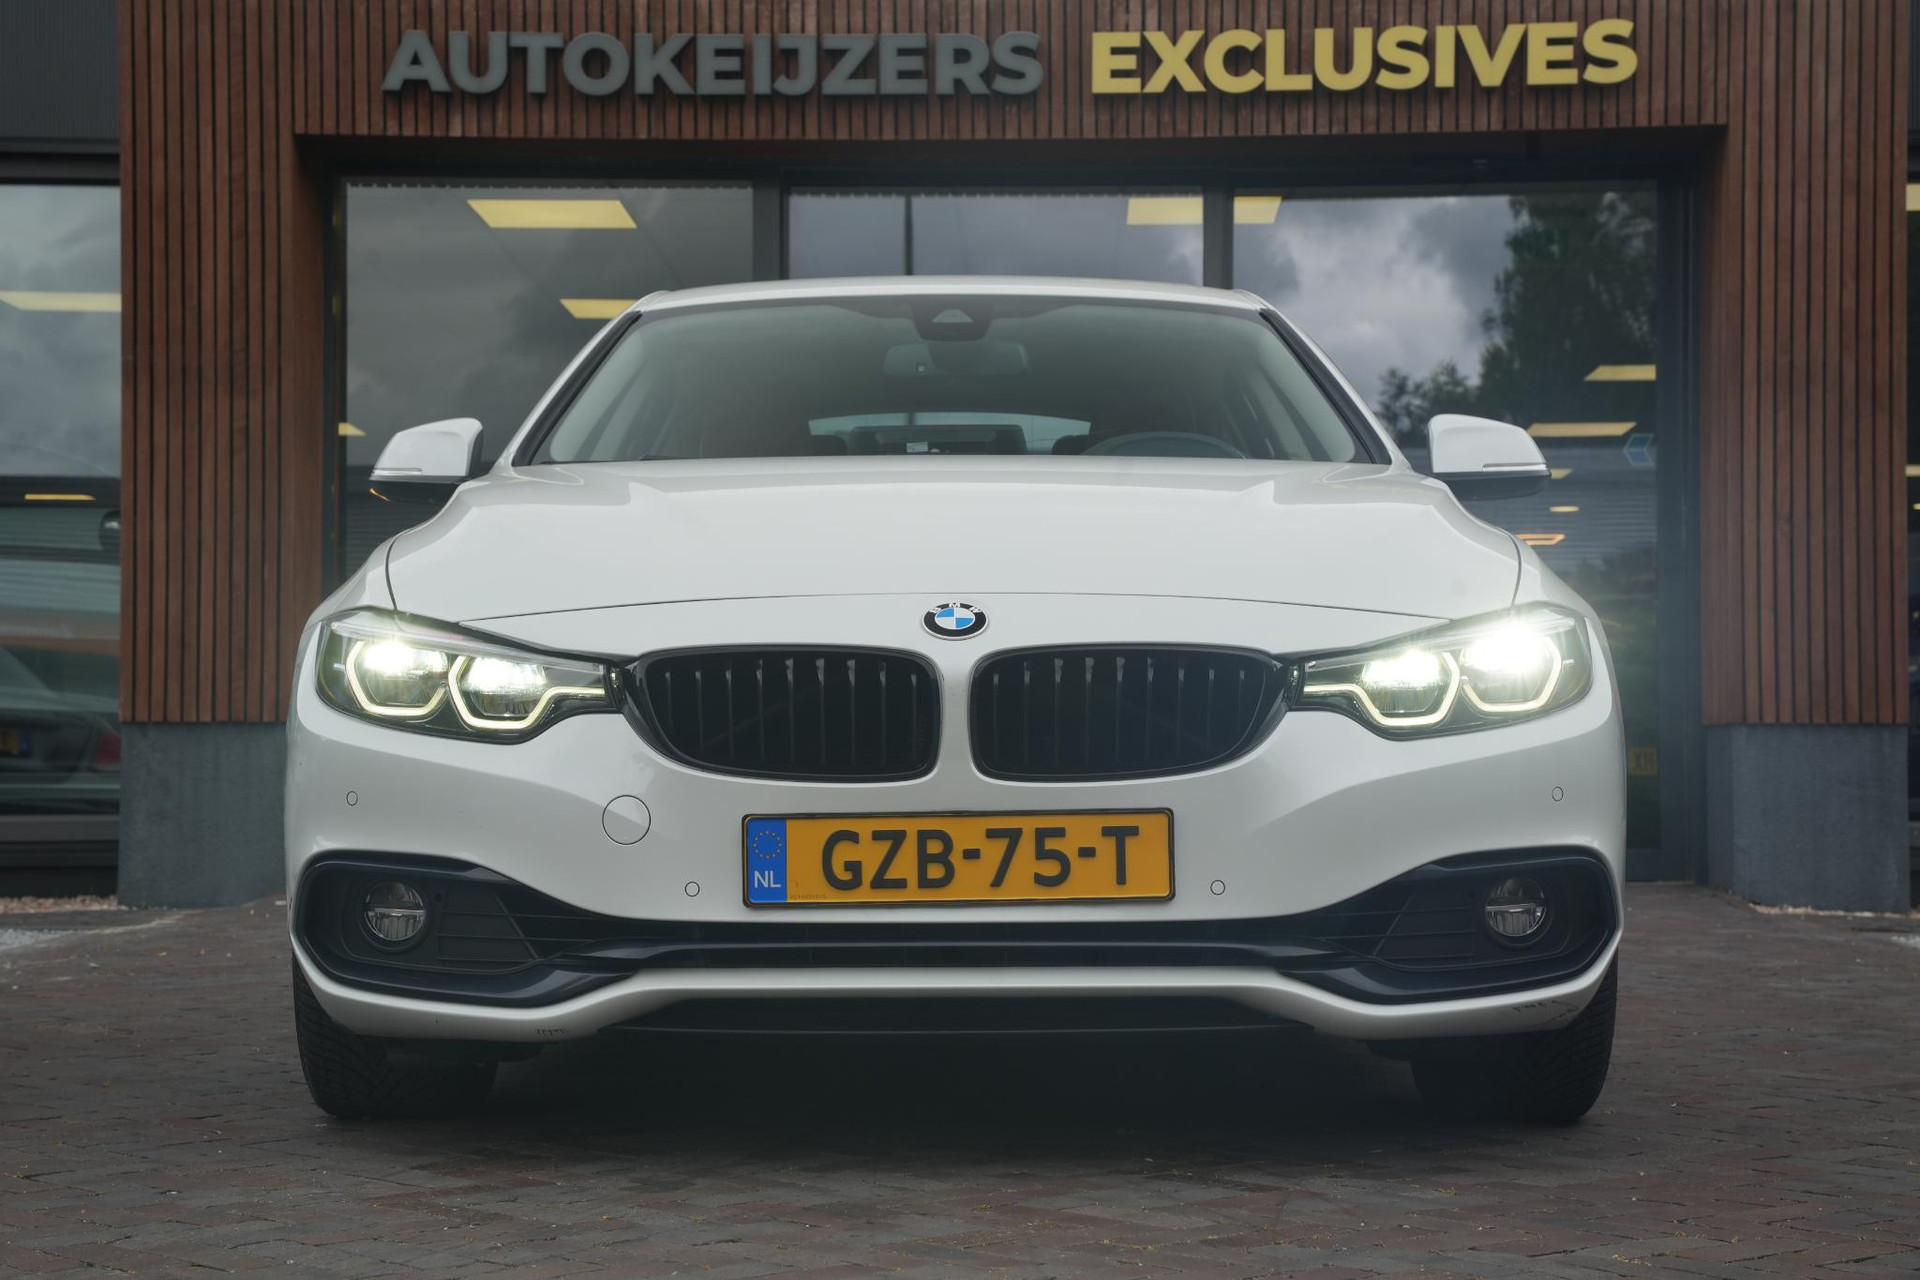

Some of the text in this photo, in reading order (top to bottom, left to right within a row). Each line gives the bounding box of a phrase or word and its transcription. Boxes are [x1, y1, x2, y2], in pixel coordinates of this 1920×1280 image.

[382, 18, 1638, 95] AUTOKEIJZERS EXCLUSIVES
[754, 870, 781, 888] NL
[822, 825, 1139, 890] GZB-75-T
